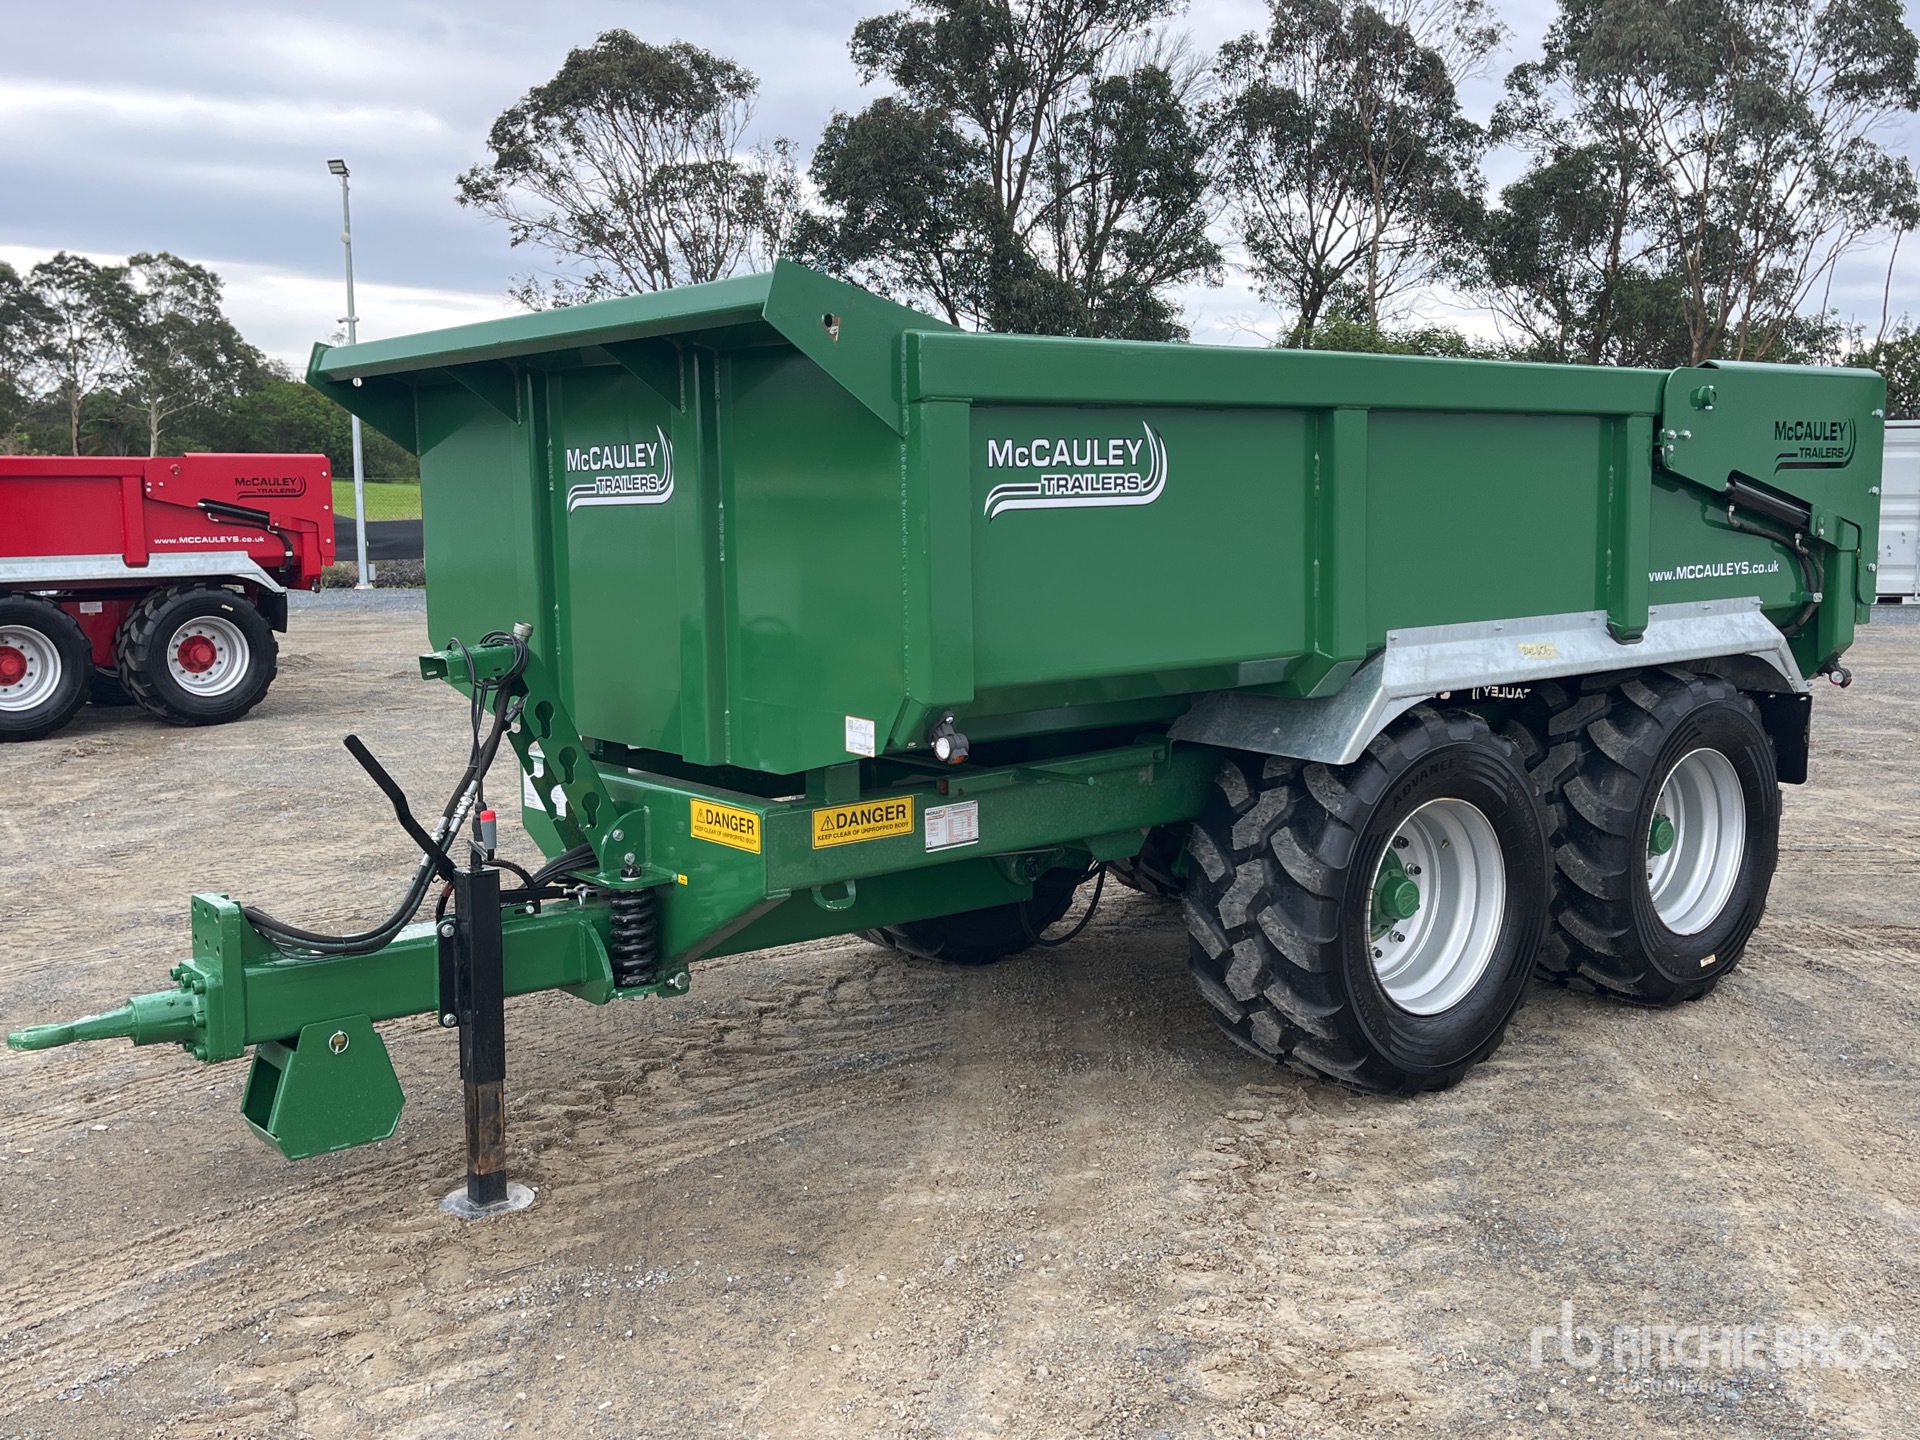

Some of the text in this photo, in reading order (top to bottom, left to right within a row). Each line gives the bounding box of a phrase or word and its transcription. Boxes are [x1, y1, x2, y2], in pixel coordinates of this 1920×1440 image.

[1774, 420, 1848, 441] McCAULEY
[566, 442, 658, 472] McCAULEY
[987, 438, 1143, 468] McCAULEY
[1799, 447, 1844, 459] TRAILERS
[234, 477, 297, 486] McCAULEY
[595, 474, 659, 494] TRAILERS
[1041, 473, 1141, 495] TRAILERS
[154, 535, 265, 545] www.MCCAULEYS.co.uk
[1648, 559, 1779, 582] www.MCCAULEYS.co.uk
[1392, 757, 1460, 809] ADVANCE
[705, 809, 755, 836] DANGER
[836, 804, 906, 829] DANGER
[817, 821, 909, 841] KEEP CLEAR OF UNPROPPED BODY
